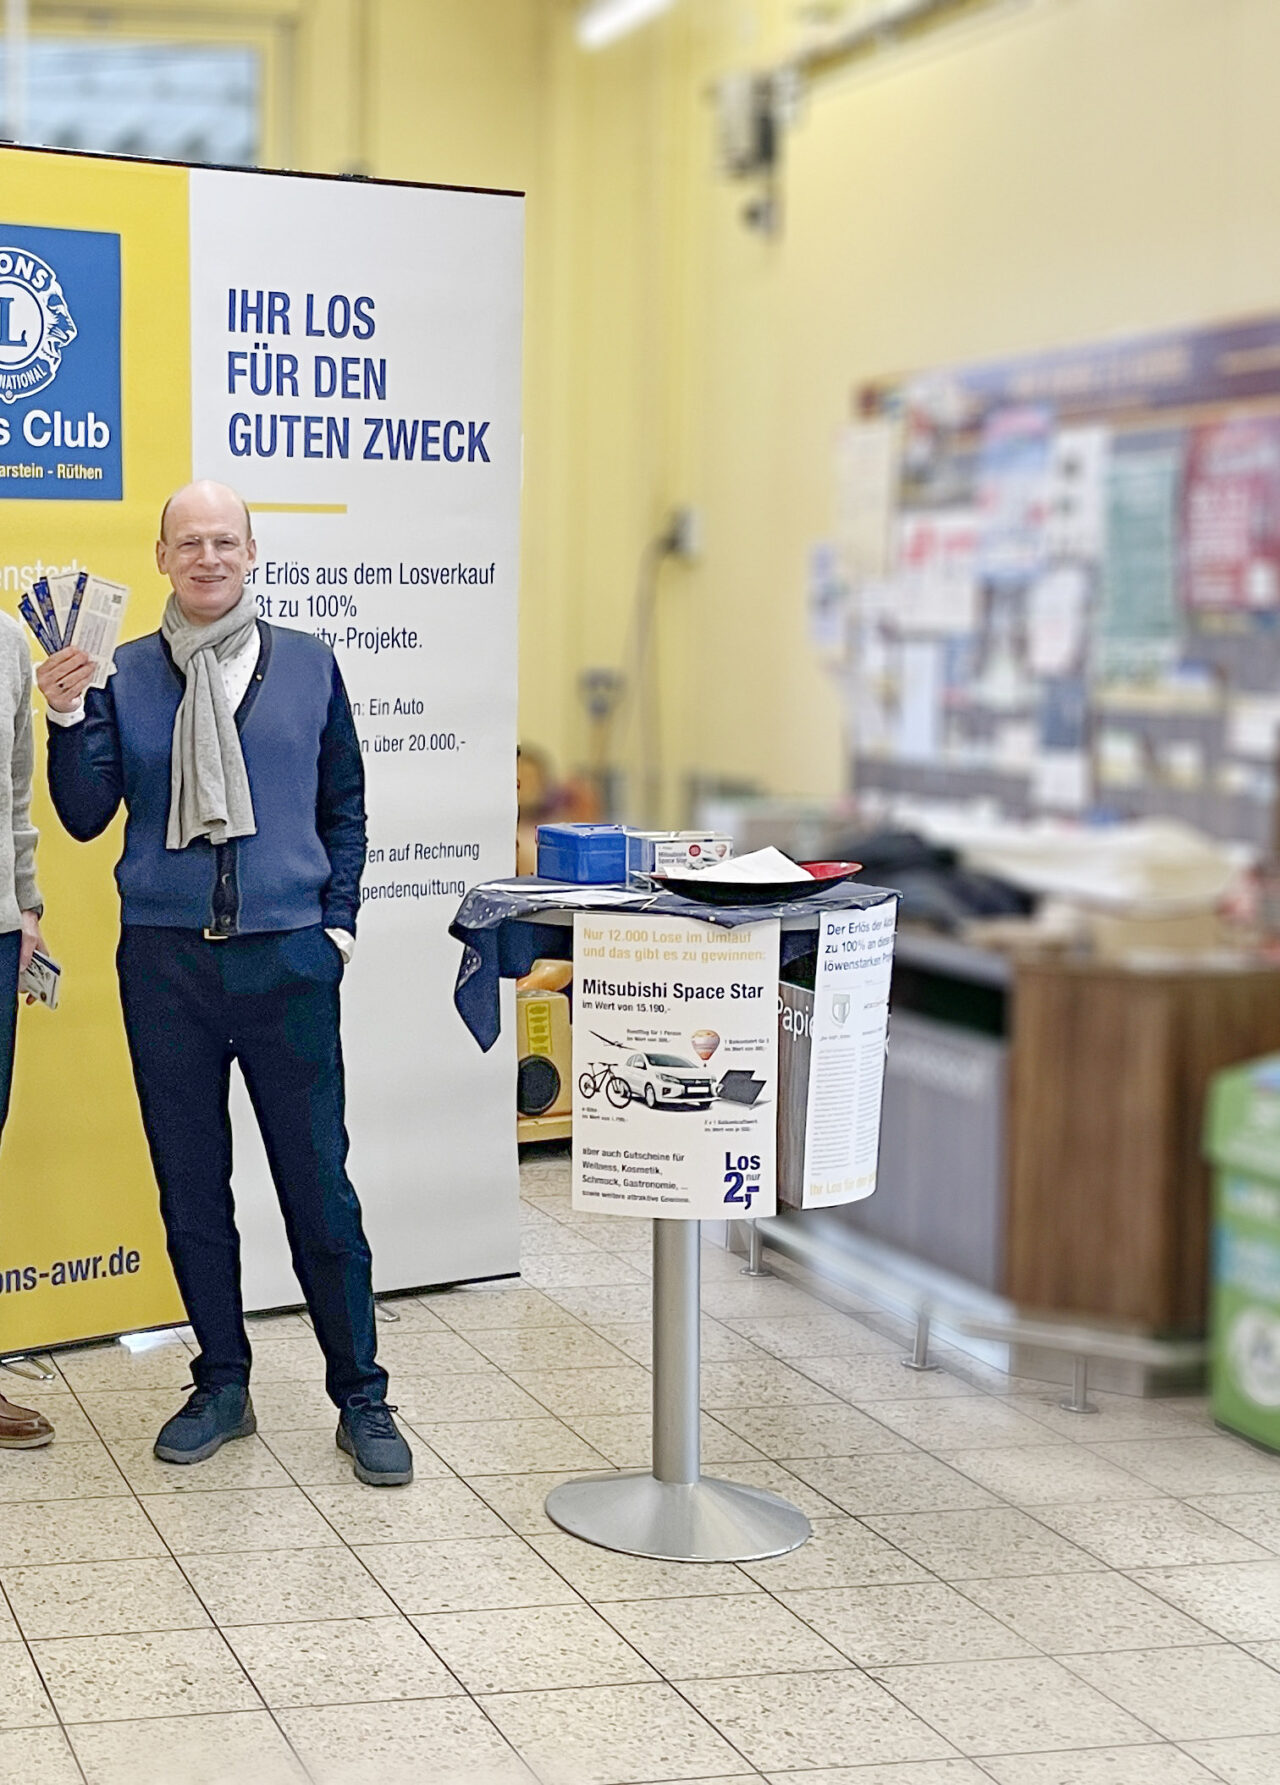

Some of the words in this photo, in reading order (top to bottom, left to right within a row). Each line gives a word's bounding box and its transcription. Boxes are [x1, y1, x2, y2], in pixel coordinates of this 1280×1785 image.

[228, 288, 291, 335] IHR
[306, 293, 376, 340] LOS
[228, 342, 299, 397] FÜR
[314, 355, 386, 400] DEN
[23, 409, 110, 449] Club
[228, 412, 350, 459] GUTEN
[363, 418, 491, 463] ZWECK
[57, 463, 103, 480] Rüthen
[266, 562, 310, 585] Erlös
[317, 567, 348, 585] aus
[354, 562, 392, 585] dem
[399, 562, 495, 585] Losverkauf
[279, 600, 299, 617] zu
[307, 595, 357, 617] 100%
[369, 698, 389, 716] Ein
[393, 698, 424, 715] Auto
[374, 735, 404, 752] über
[408, 733, 466, 752] 20.000,-
[389, 844, 410, 862] auf
[414, 841, 480, 862] Rechnung
[362, 879, 466, 904] pendenquittung
[584, 928, 604, 941] Nur
[609, 929, 648, 942] 12.000
[652, 930, 682, 943] Lose
[687, 931, 702, 943] im
[707, 930, 752, 944] Umlauf
[827, 924, 846, 936] Der
[849, 921, 870, 935] Erlös
[584, 946, 605, 958] und
[609, 947, 630, 960] das
[635, 948, 659, 962] gibt
[663, 951, 678, 961] es
[682, 951, 697, 961] zu
[701, 950, 766, 963] gewinnen:
[825, 944, 838, 954] zu
[842, 940, 865, 952] 100%
[582, 978, 667, 998] Mitsubishi
[673, 982, 725, 1002] Space
[729, 983, 764, 999] Star
[582, 1001, 593, 1009] im
[595, 1001, 615, 1011] Wert
[617, 1003, 633, 1011] von
[582, 1148, 600, 1156] aber
[602, 1149, 622, 1158] auch
[624, 1150, 670, 1161] Gutscheine
[672, 1153, 685, 1161] für
[725, 1152, 761, 1171] Los
[746, 1173, 761, 1181] nur
